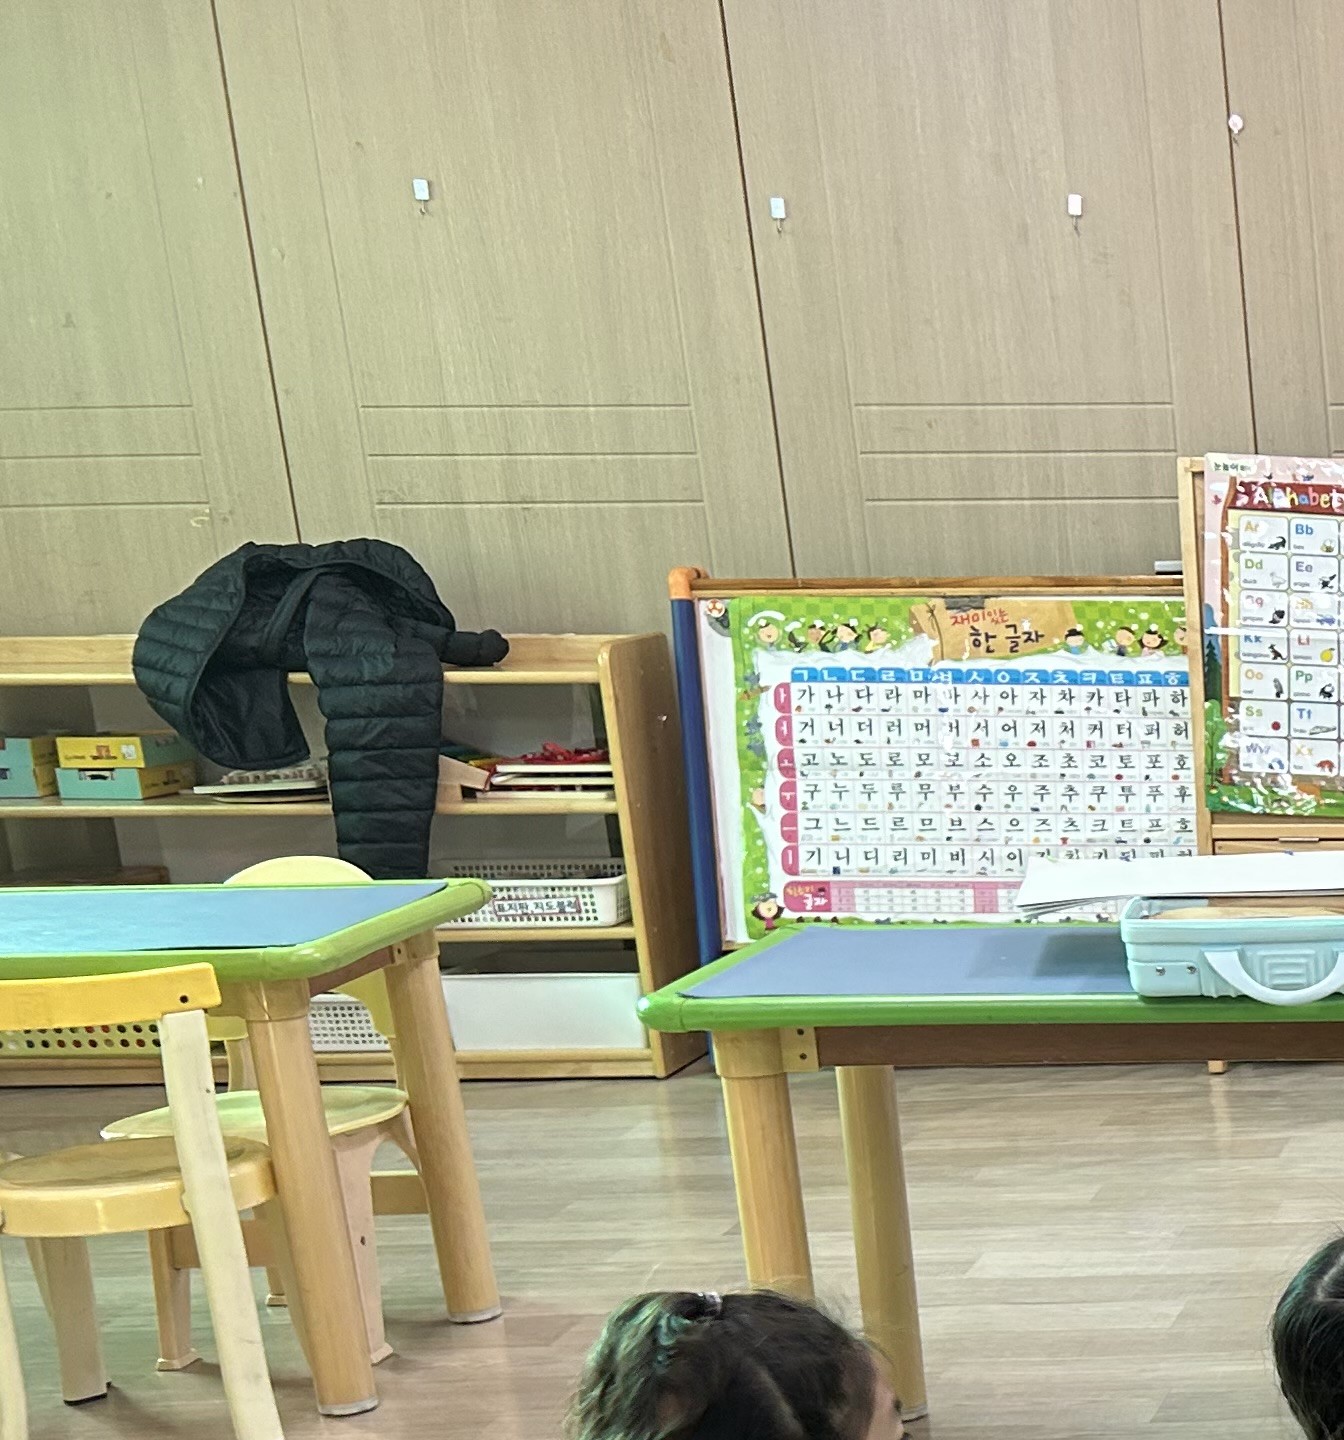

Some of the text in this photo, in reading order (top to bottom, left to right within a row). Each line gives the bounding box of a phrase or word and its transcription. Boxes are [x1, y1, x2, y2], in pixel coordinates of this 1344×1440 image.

[1295, 523, 1314, 536] Bb
[1244, 558, 1264, 570] Dd
[1296, 560, 1313, 573] Ee
[950, 607, 1010, 626] 재미있는
[969, 624, 1045, 654] 한 글자
[1244, 669, 1264, 681] Oo
[1295, 670, 1313, 683] Pp
[798, 684, 816, 705] 가
[827, 685, 844, 704] 나
[854, 684, 874, 705] 다
[885, 685, 903, 705] 라
[912, 685, 932, 705] 마
[972, 686, 990, 705] 사
[999, 686, 1019, 706] 아
[1029, 687, 1048, 706] 자
[1058, 687, 1076, 706] 차
[1086, 688, 1103, 707] 카
[1115, 688, 1132, 707] 타
[1170, 689, 1188, 707] 하
[1245, 705, 1263, 717] Ss
[1296, 707, 1313, 720] Tt
[799, 717, 815, 736] 거
[827, 717, 844, 737] 너
[856, 717, 873, 737] 더
[886, 718, 902, 737] 러
[913, 718, 931, 737] 머
[972, 718, 989, 738] 서
[1001, 719, 1018, 738] 어
[1030, 719, 1046, 739] 저
[1059, 719, 1075, 739] 처
[1087, 720, 1104, 740] 커
[1116, 720, 1132, 740] 터
[1173, 721, 1190, 740] 허
[801, 753, 820, 767] 고
[829, 752, 849, 767] 노
[858, 752, 877, 768] 도
[885, 751, 905, 767] 로
[915, 752, 934, 768] 모
[973, 752, 993, 768] 소
[1002, 752, 1022, 768] 오
[1031, 754, 1050, 769] 조
[1060, 752, 1079, 769] 초
[1088, 754, 1107, 769] 코
[1117, 754, 1136, 770] 토
[1144, 753, 1165, 770] 포
[801, 783, 822, 804] 구
[831, 782, 850, 802] 누
[860, 783, 878, 802] 두
[917, 783, 936, 802] 무
[974, 783, 994, 803] 수
[1004, 784, 1024, 803] 우
[1033, 784, 1052, 803] 주
[1061, 784, 1080, 804] 추
[1089, 785, 1108, 804] 쿠
[1145, 784, 1165, 803] 푸
[804, 817, 823, 831] 그
[833, 817, 852, 832] 느
[861, 817, 881, 831] 드
[890, 816, 909, 832] 르
[918, 817, 938, 832] 므
[947, 816, 967, 832] 브
[976, 817, 996, 832] 스
[1005, 817, 1025, 833] 으
[1033, 818, 1053, 833] 즈
[1062, 817, 1081, 833] 츠
[1090, 818, 1109, 833] 크
[1118, 818, 1138, 833] 트
[806, 847, 822, 866] 기
[835, 848, 850, 865] 니
[863, 847, 879, 866] 디
[892, 847, 908, 866] 리
[920, 847, 937, 866] 미
[949, 847, 966, 867] 비
[979, 848, 995, 866] 시
[1006, 848, 1024, 867] 이
